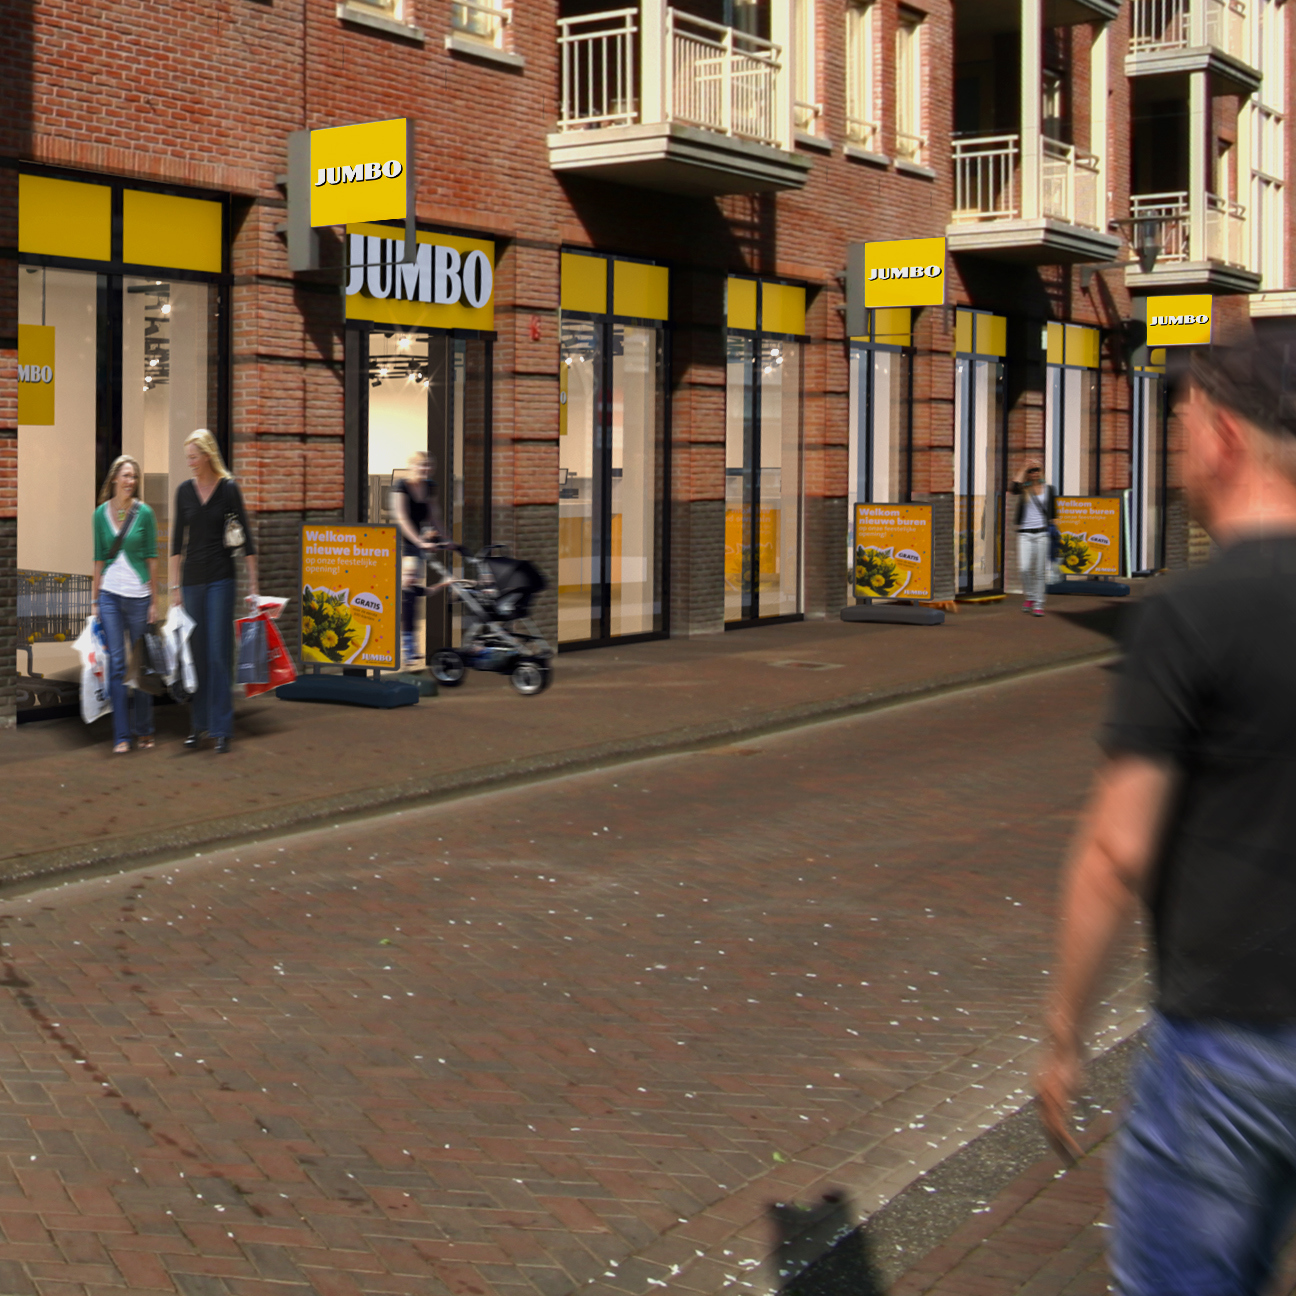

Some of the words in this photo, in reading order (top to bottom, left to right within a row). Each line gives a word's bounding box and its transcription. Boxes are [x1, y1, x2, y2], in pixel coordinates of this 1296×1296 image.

[314, 160, 403, 186] JUMBO
[346, 233, 493, 308] JUMBO
[868, 265, 942, 281] JUMBO
[1149, 314, 1210, 326] JUMBO
[18, 364, 53, 384] MBO
[858, 508, 900, 517] Welkom
[859, 517, 895, 525] nieuwe
[897, 517, 926, 526] buren
[305, 530, 357, 543] Welkom
[306, 543, 350, 555] nieuwe
[353, 544, 389, 557] buren
[305, 558, 315, 566] op
[337, 557, 377, 568] feestelijke
[898, 552, 919, 562] GRATIS
[305, 565, 340, 575] opening!
[354, 597, 380, 610] GRATIS
[361, 653, 393, 662] JUMBO
